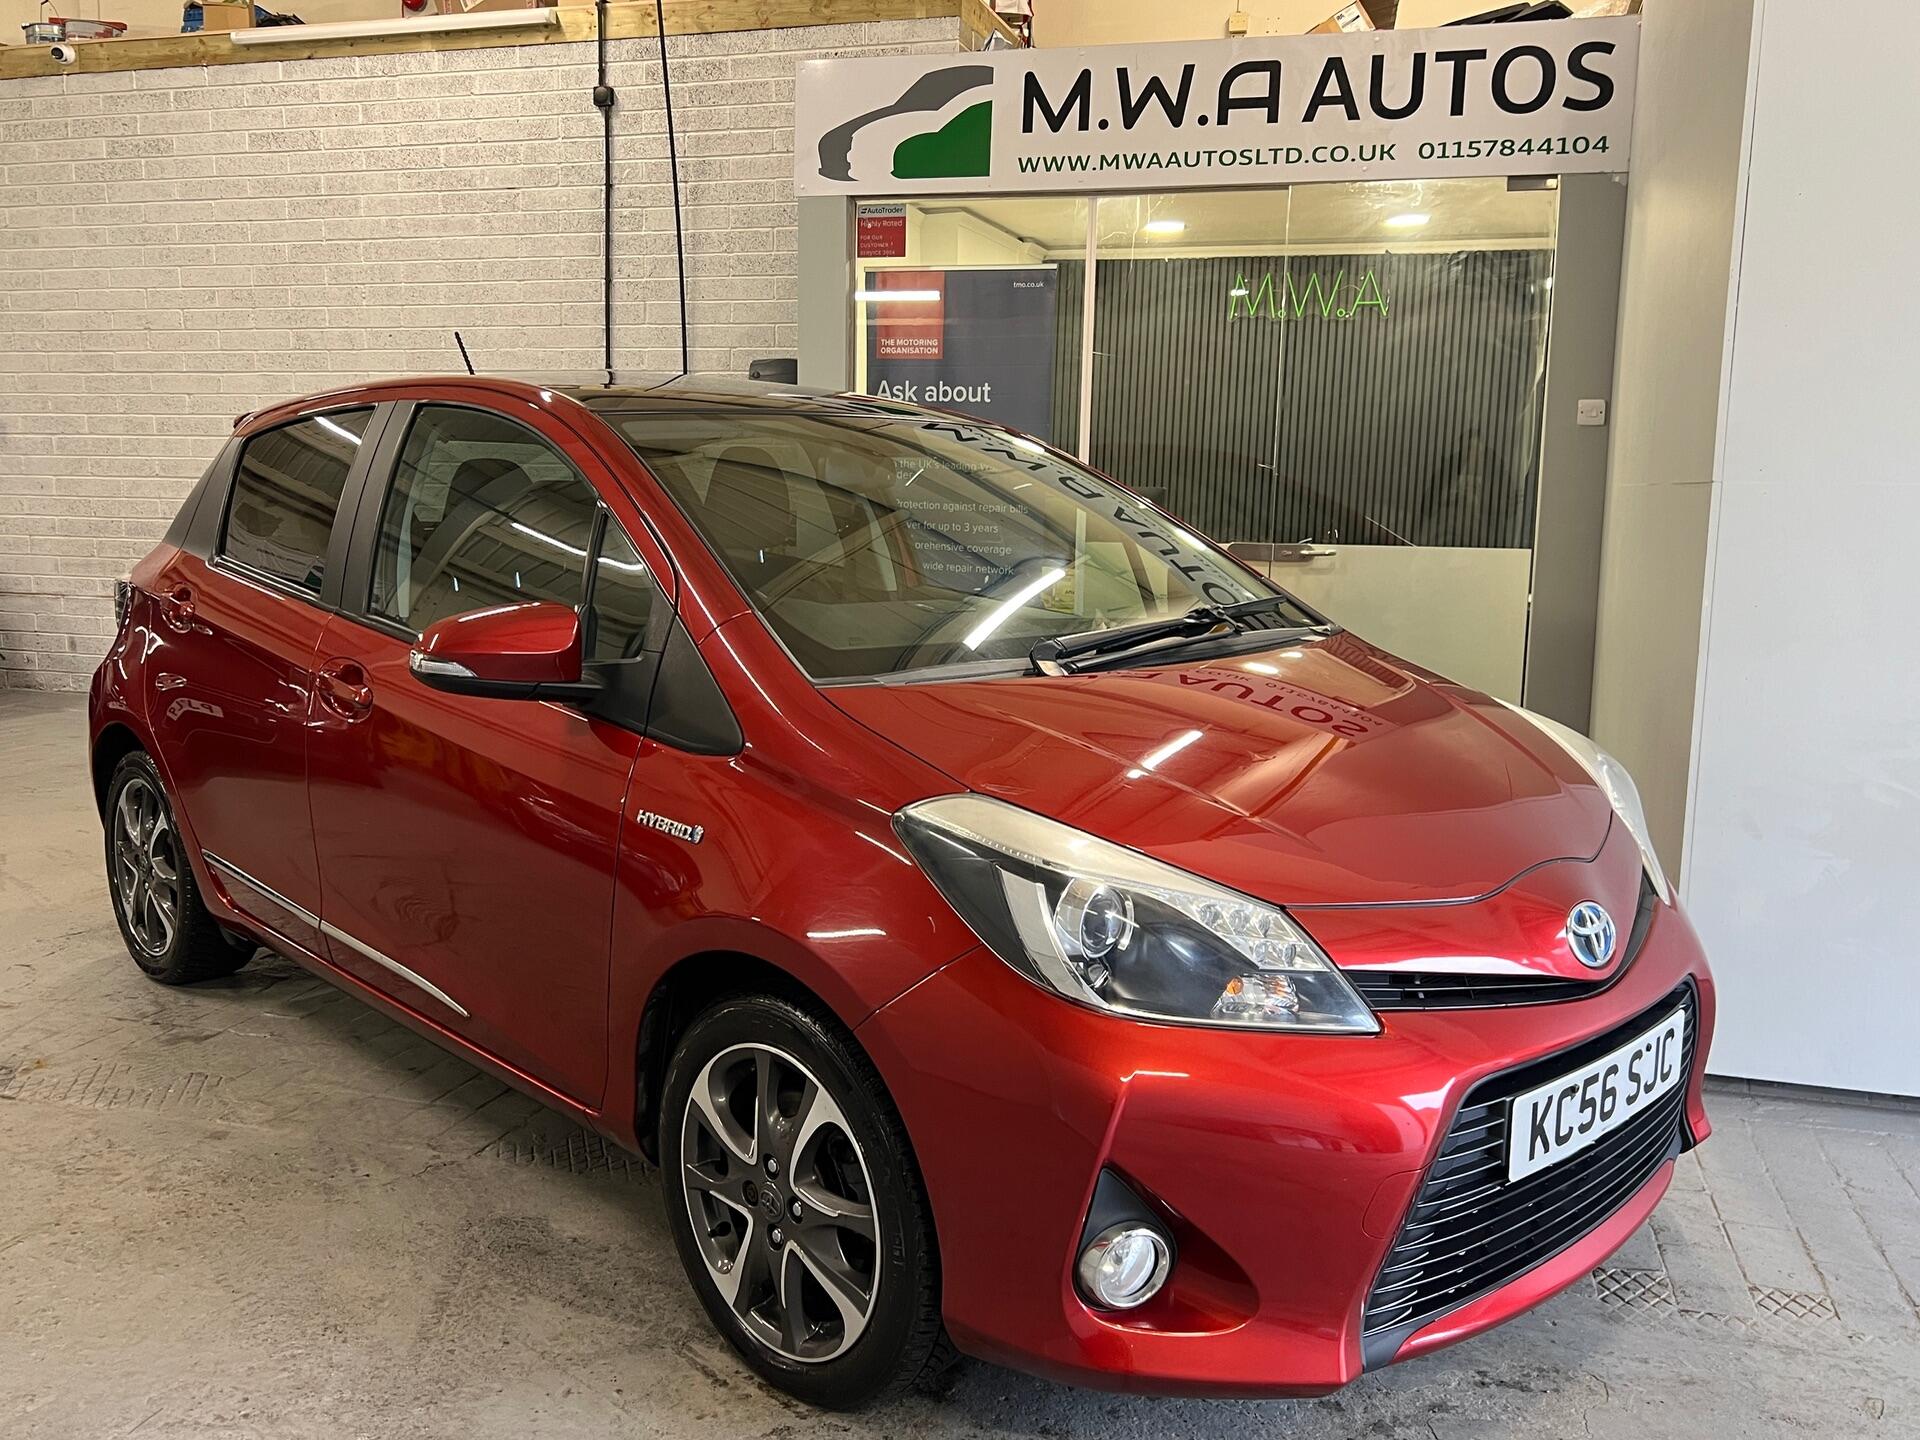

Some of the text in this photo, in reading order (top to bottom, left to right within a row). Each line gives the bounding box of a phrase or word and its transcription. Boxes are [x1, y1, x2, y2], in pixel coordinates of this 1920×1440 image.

[1022, 41, 1616, 133] M.W.A AUTOS
[1018, 135, 1609, 173] WWW.MWAAUTOSLTD.CO.UK 01157844104
[883, 219, 903, 227] Rated
[877, 380, 991, 403] Ask about
[897, 471, 913, 480] der
[942, 502, 976, 512] against
[979, 503, 1006, 514] repair
[1009, 504, 1029, 514] bills
[907, 520, 999, 534] ver for up to 3 years
[966, 544, 1012, 556] coverage
[946, 563, 972, 573] repair
[975, 565, 1014, 575] network
[637, 809, 692, 839] HYBRID
[1529, 1027, 1675, 1162] KC56 SJC
